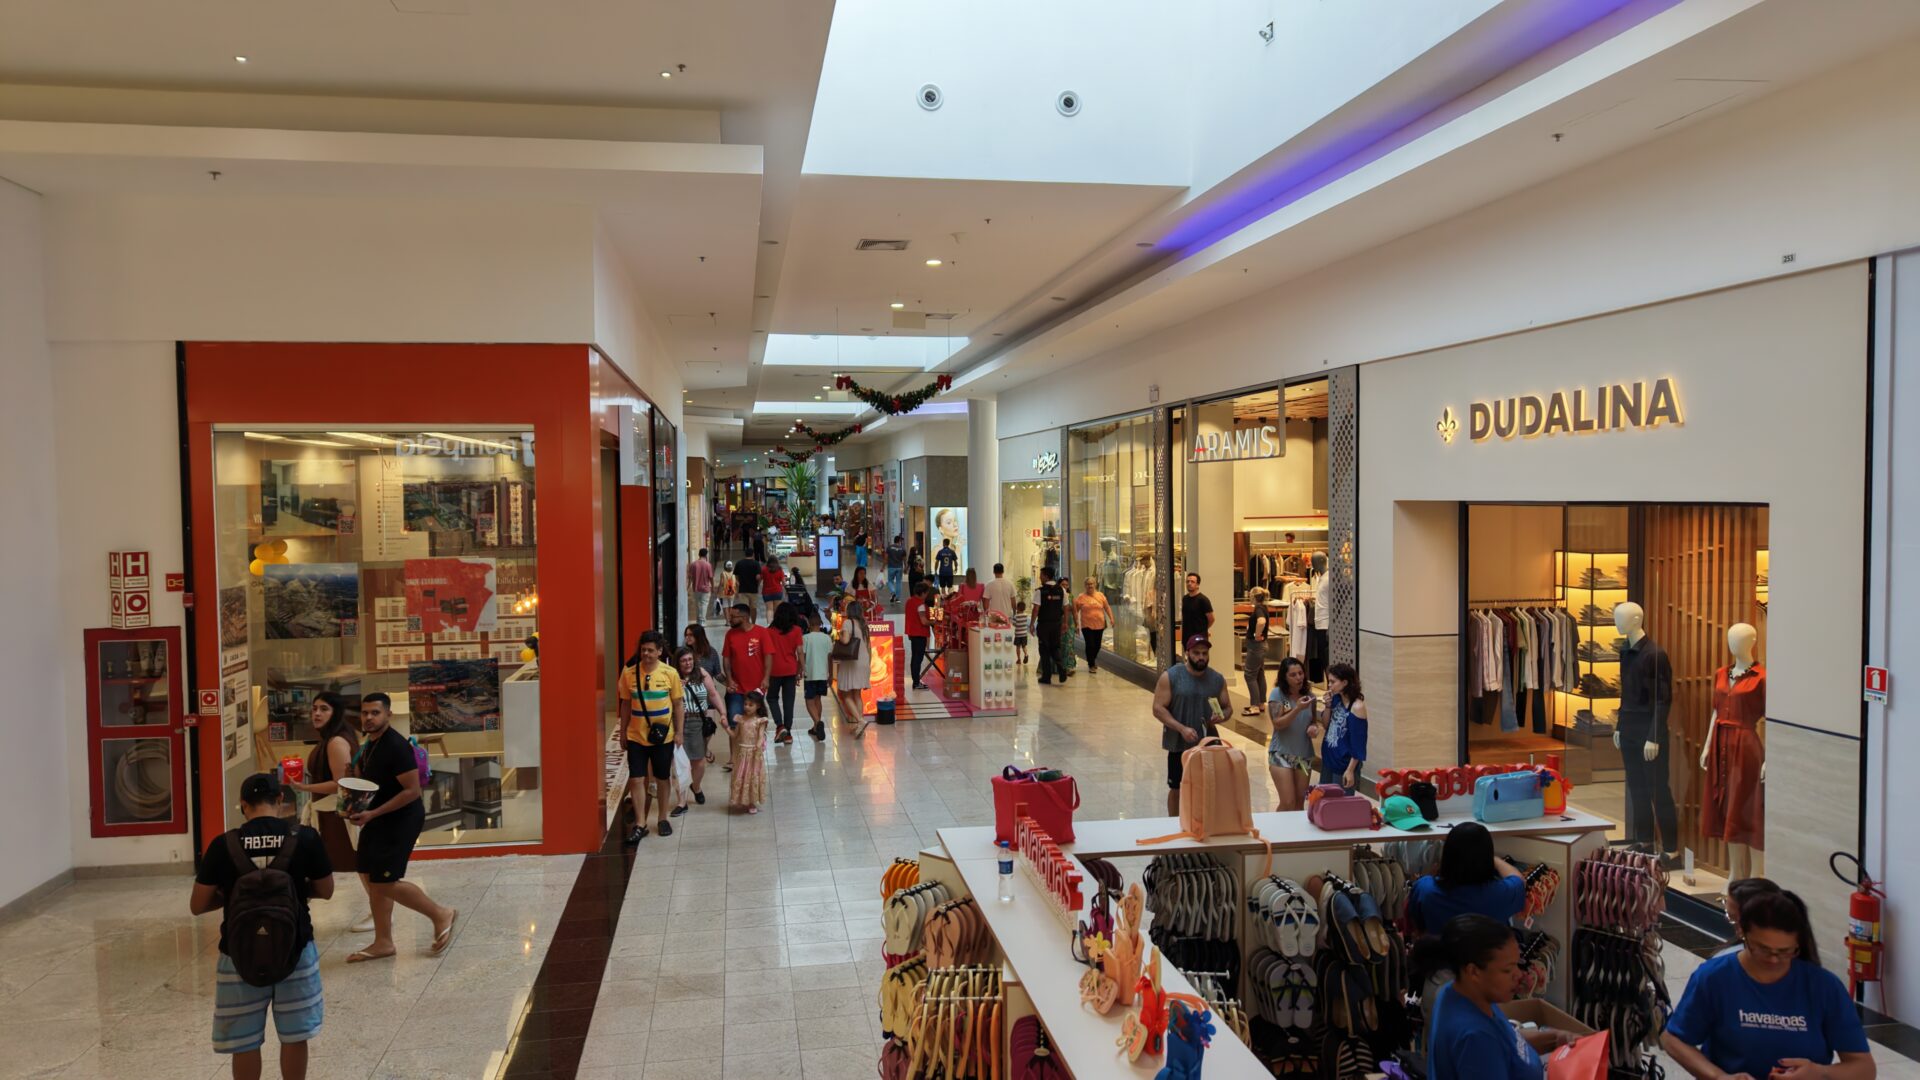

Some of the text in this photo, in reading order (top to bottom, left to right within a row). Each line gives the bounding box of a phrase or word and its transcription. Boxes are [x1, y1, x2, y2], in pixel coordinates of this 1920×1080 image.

[1469, 377, 1685, 441] DUDALINA
[1193, 425, 1277, 462] ARAMIS
[126, 554, 146, 576] H
[943, 556, 950, 567] 9
[1738, 1009, 1807, 1027] havaianas
